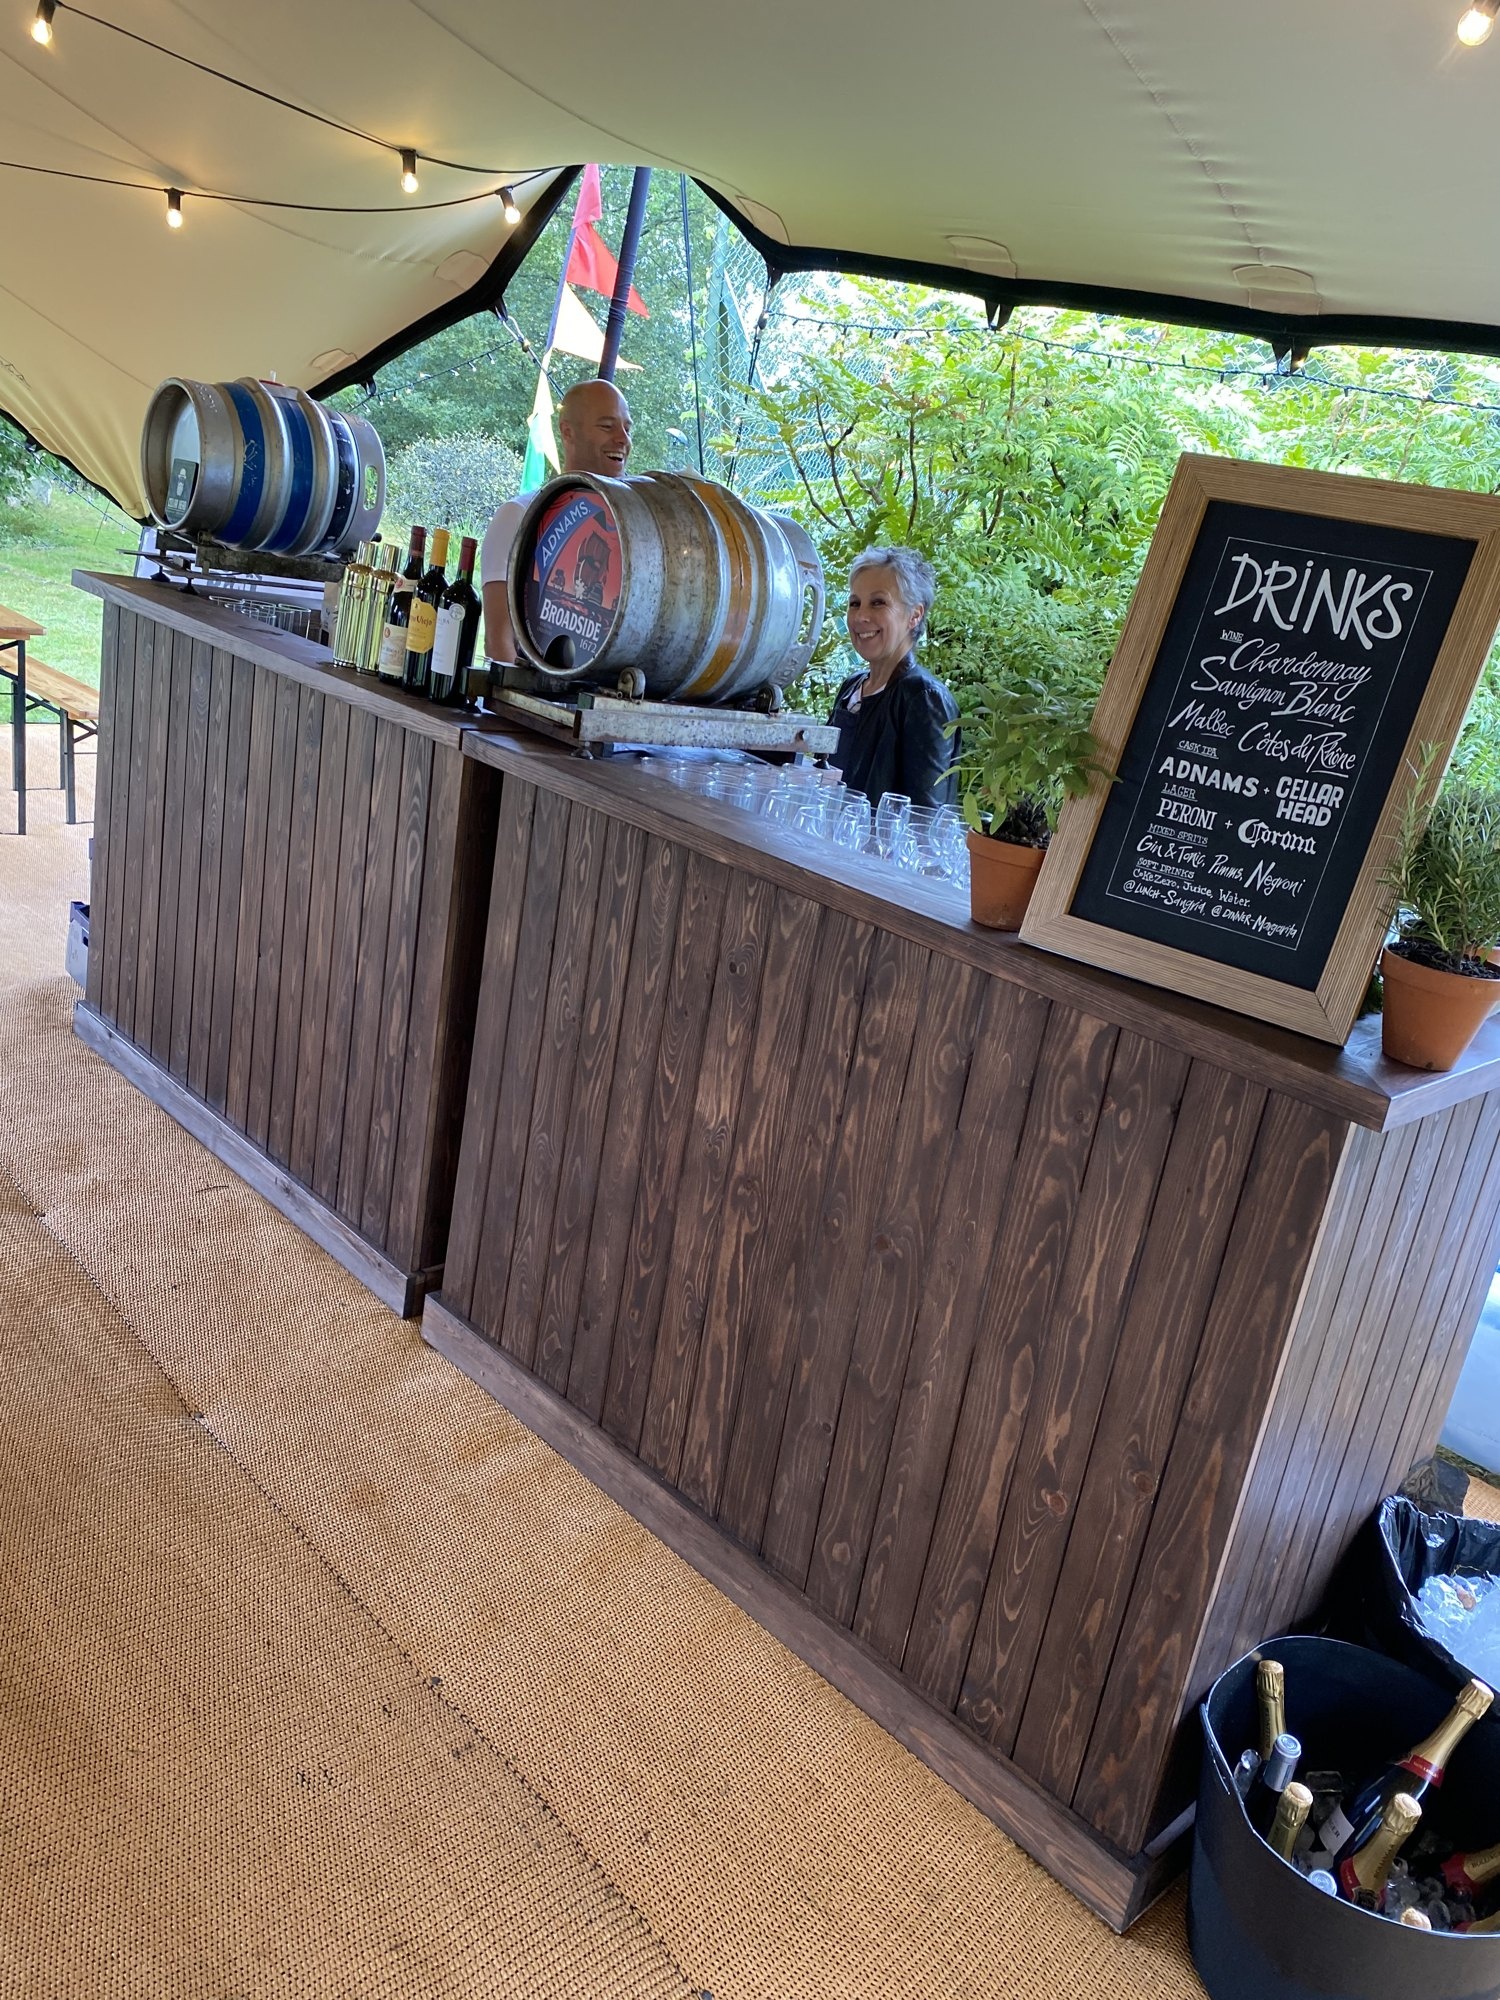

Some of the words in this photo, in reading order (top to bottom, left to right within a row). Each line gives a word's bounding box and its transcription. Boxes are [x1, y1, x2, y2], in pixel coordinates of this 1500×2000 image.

[541, 501, 589, 568] ADNAMS
[539, 598, 602, 642] BROADSIDE
[1220, 629, 1244, 643] WINE
[579, 638, 597, 654] 1672
[1191, 655, 1284, 710] Sauvignon
[1270, 681, 1356, 723] Blanc
[1229, 638, 1372, 701] Chardonnay
[1168, 699, 1236, 736] Malbec
[1238, 722, 1290, 762] Côtes
[1291, 733, 1315, 763] du
[1306, 732, 1356, 773] Rhône
[1178, 740, 1200, 754] CASK
[1202, 746, 1218, 758] IPA
[1158, 756, 1260, 797] ADNAMS
[1275, 776, 1345, 809] CELLAR
[1162, 782, 1197, 800] LAGER
[1148, 823, 1176, 838] MIXED
[1156, 797, 1217, 831] PERONI
[1237, 818, 1317, 855] Corona
[1275, 799, 1332, 827] HEAD
[1136, 835, 1163, 858] Gin
[1164, 842, 1177, 860] &
[1243, 859, 1306, 897] Negroni
[1136, 857, 1159, 871] SOFT
[1159, 862, 1195, 880] DRINKS
